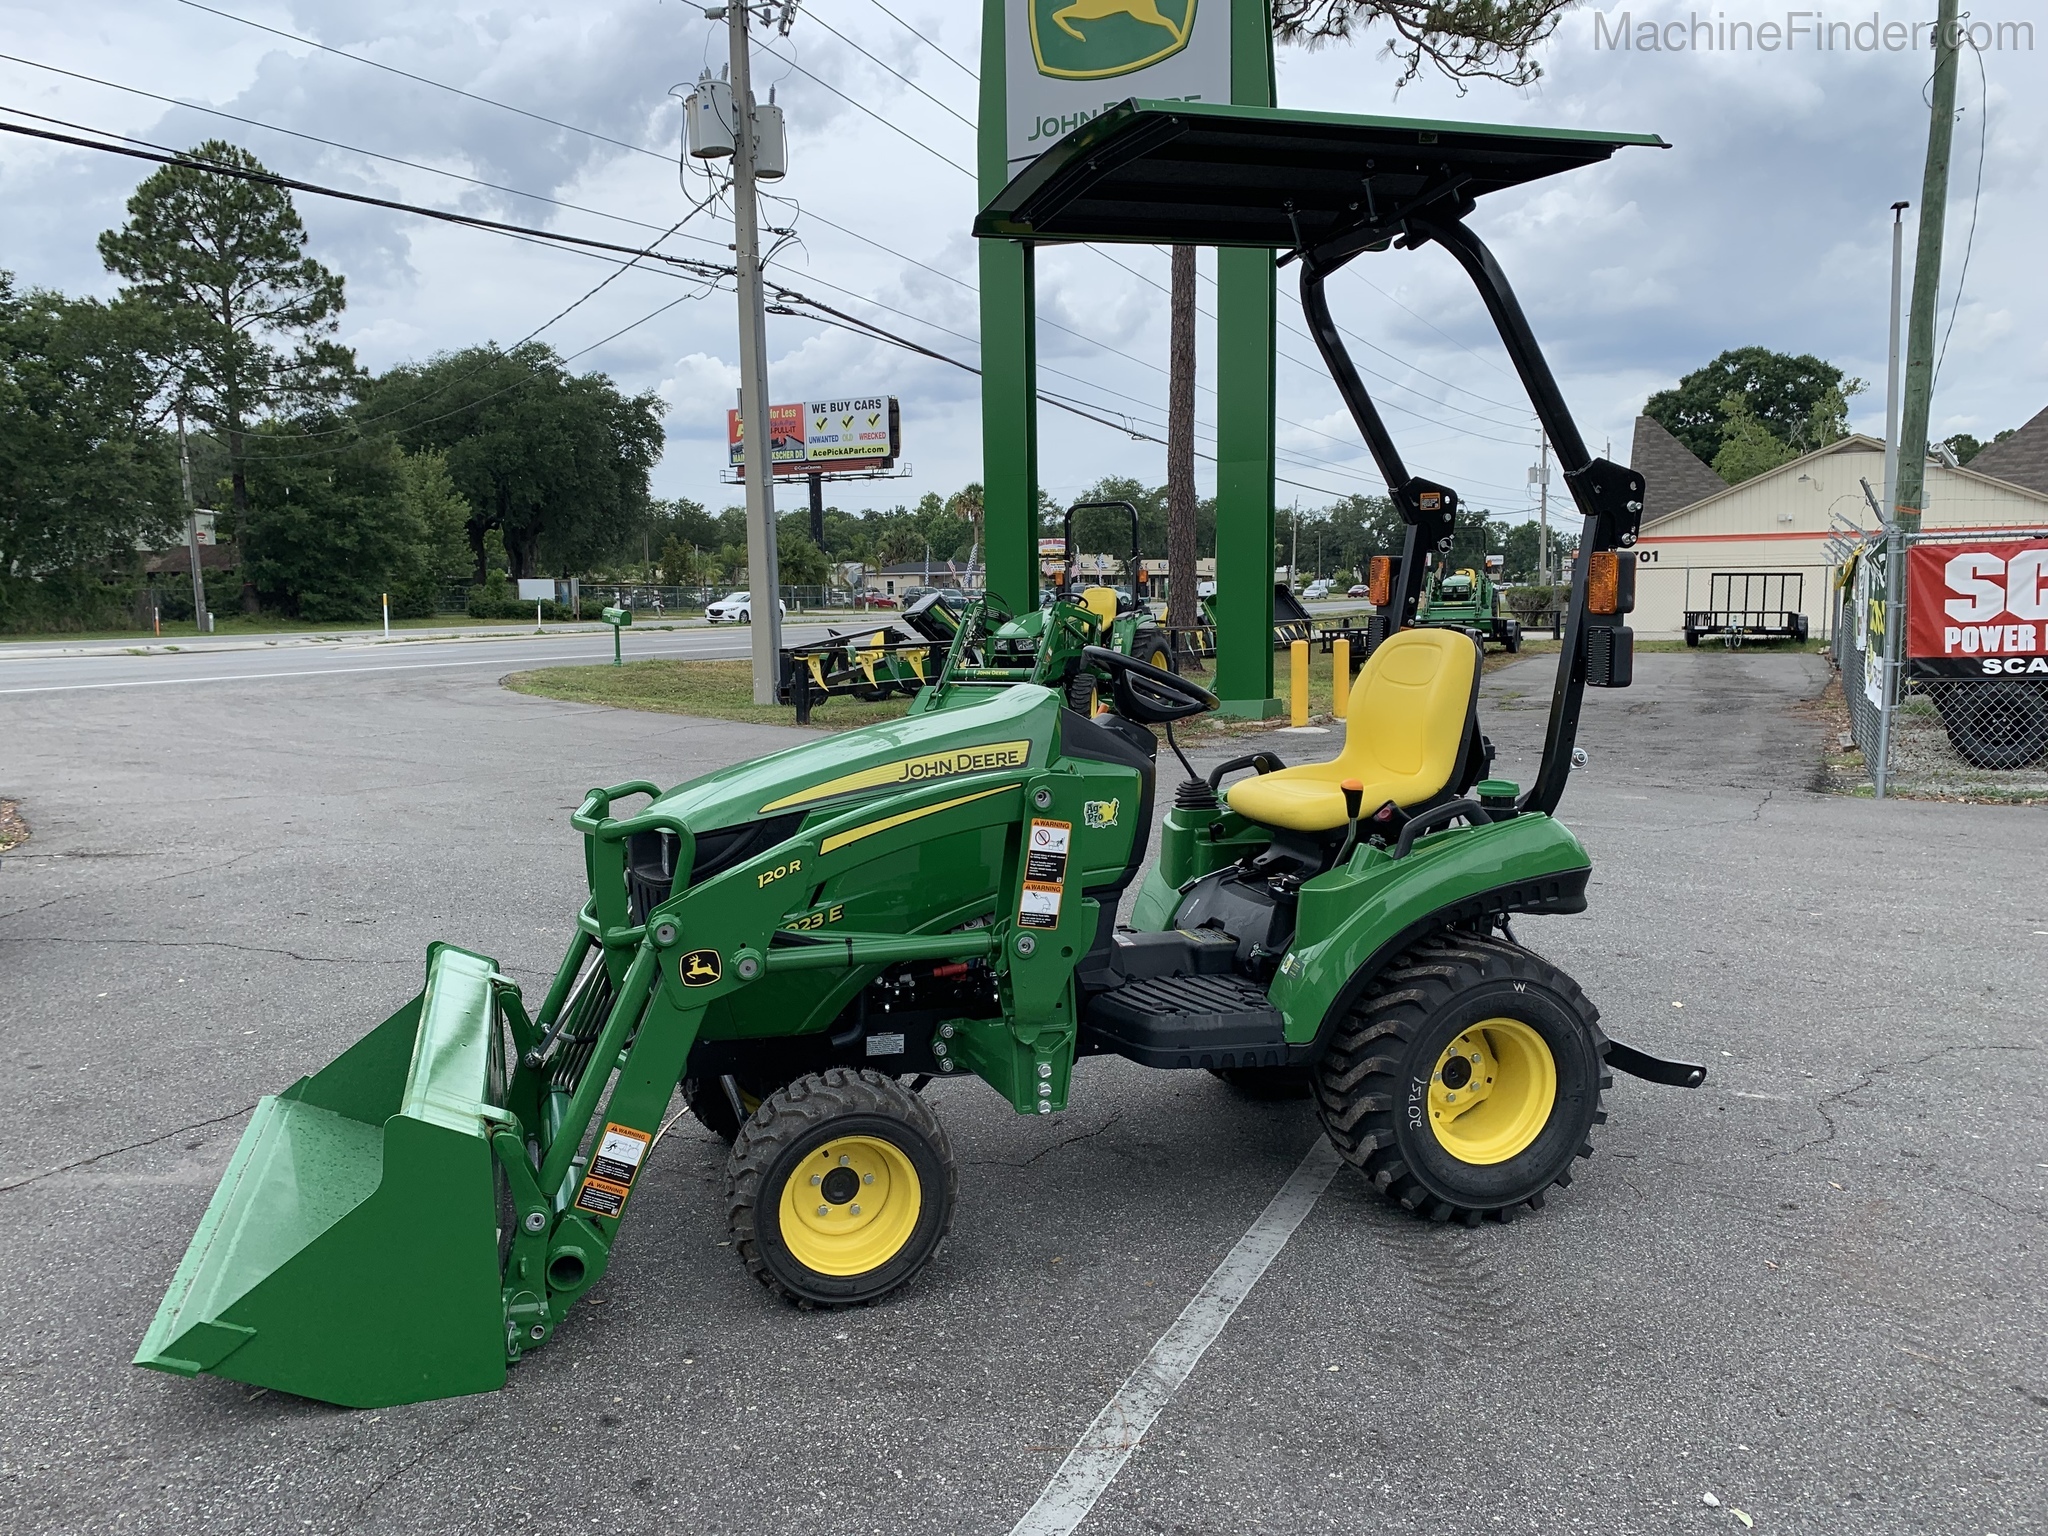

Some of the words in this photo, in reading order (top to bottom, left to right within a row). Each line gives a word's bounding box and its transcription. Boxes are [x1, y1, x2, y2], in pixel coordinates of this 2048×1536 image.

[812, 403, 827, 414] WE
[830, 401, 851, 413] BUY
[854, 399, 882, 411] CARS
[781, 407, 797, 418] Less
[808, 434, 839, 445] UNWANTED
[842, 433, 853, 442] OLD
[859, 431, 887, 441] WRECKED
[795, 449, 804, 459] DR
[812, 446, 884, 457] AcePickAPart.com
[1944, 624, 2037, 654] POWER
[898, 758, 953, 781] JOHN
[956, 750, 1020, 771] DEERE
[1087, 812, 1104, 824] Pro
[1039, 820, 1070, 830] WARNING
[757, 866, 787, 889] 120
[789, 859, 801, 874] R
[1030, 884, 1061, 893] WARNING
[828, 904, 844, 923] E
[618, 1128, 646, 1140] WARNING
[596, 1183, 623, 1194] WARNING
